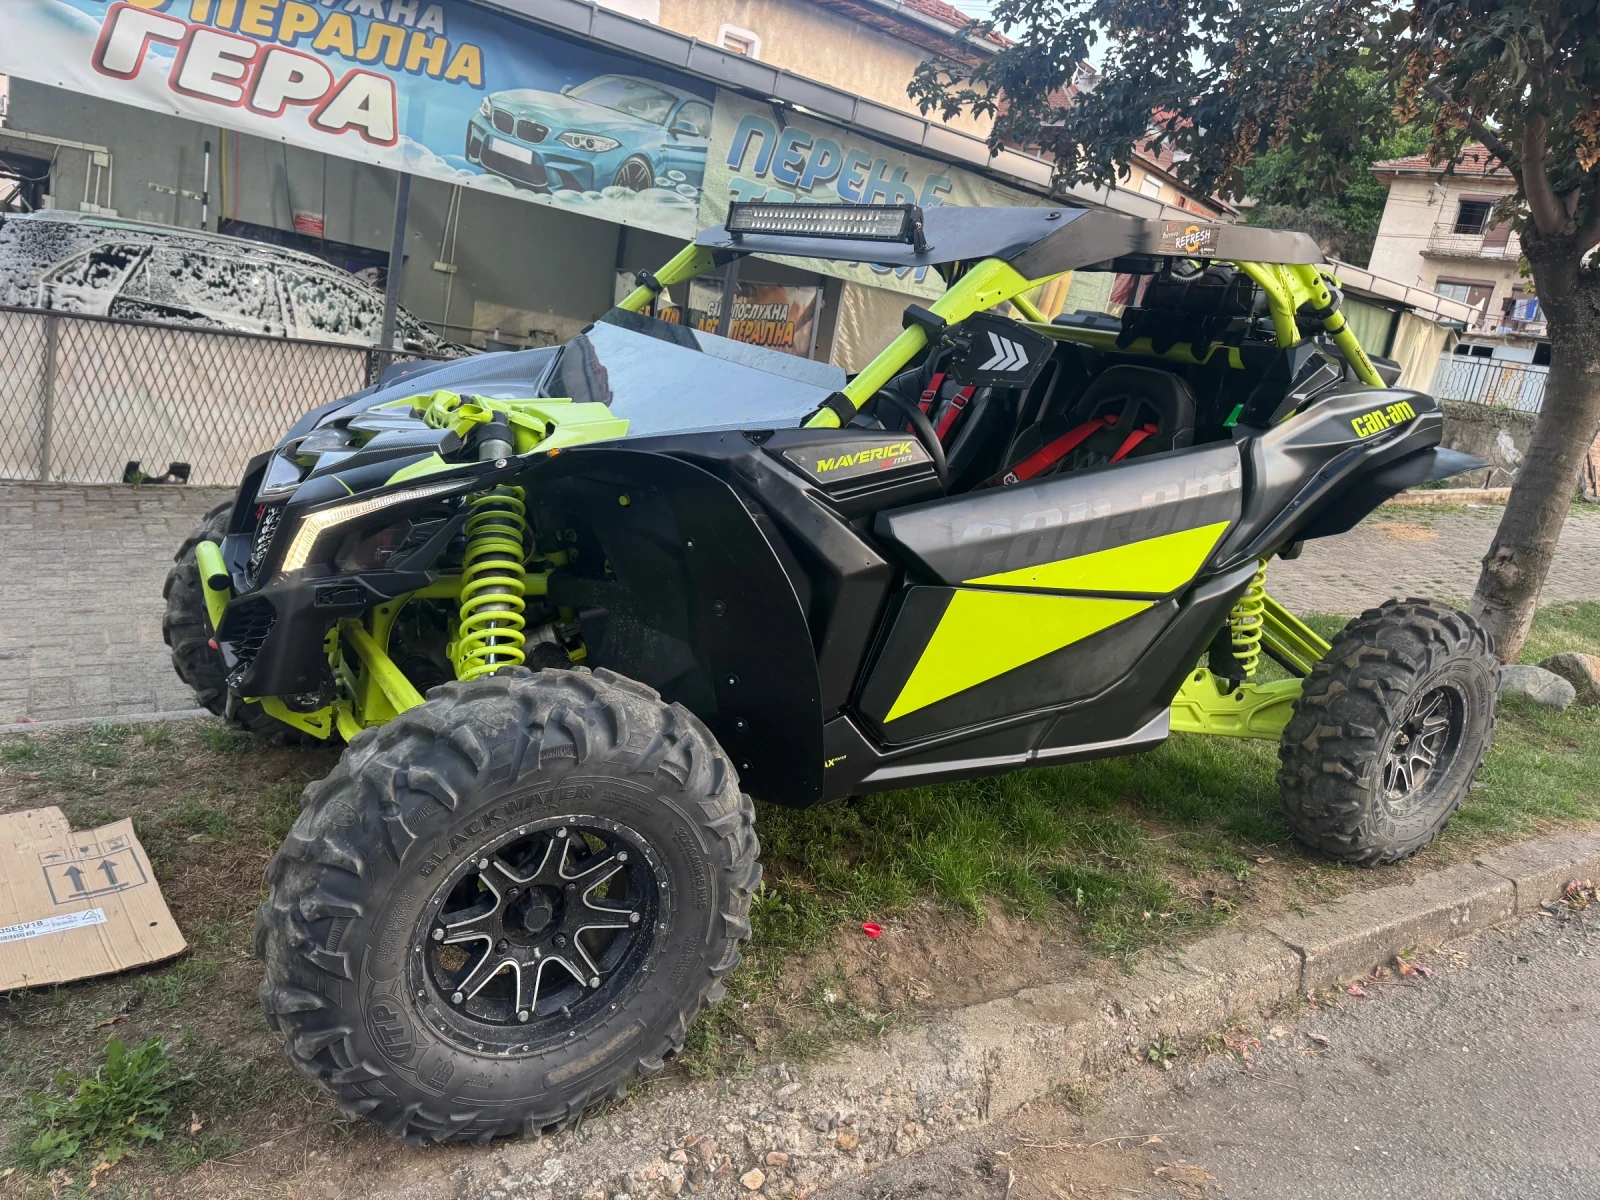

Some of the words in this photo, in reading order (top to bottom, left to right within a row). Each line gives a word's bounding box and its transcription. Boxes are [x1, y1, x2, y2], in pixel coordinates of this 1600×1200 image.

[93, 2, 398, 146] ГЕРА
[1175, 229, 1211, 249] REFRESH
[729, 320, 794, 347] ПЕРАЛНА
[1351, 400, 1417, 439] can-am
[816, 441, 914, 473] MAVERICK
[417, 784, 594, 881] BLACKWATER
[370, 1003, 412, 1057] ITP
